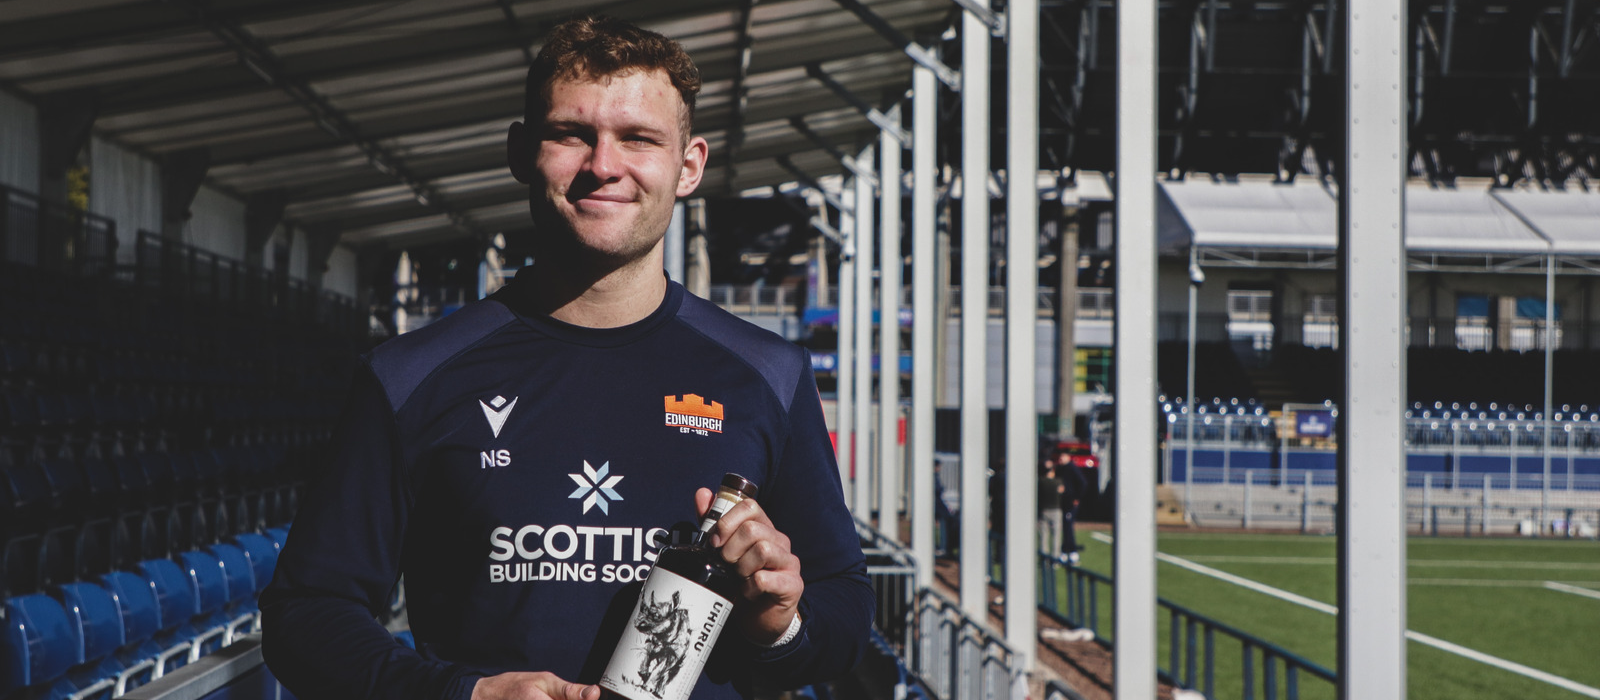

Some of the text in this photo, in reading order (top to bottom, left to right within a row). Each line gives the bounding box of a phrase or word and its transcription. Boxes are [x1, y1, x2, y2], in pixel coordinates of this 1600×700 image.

[665, 412, 722, 431] EDINBURGH
[480, 450, 511, 469] NS
[489, 524, 699, 562] SCOTTIS
[490, 562, 597, 583] BUILDING
[694, 601, 723, 652] UHURU
